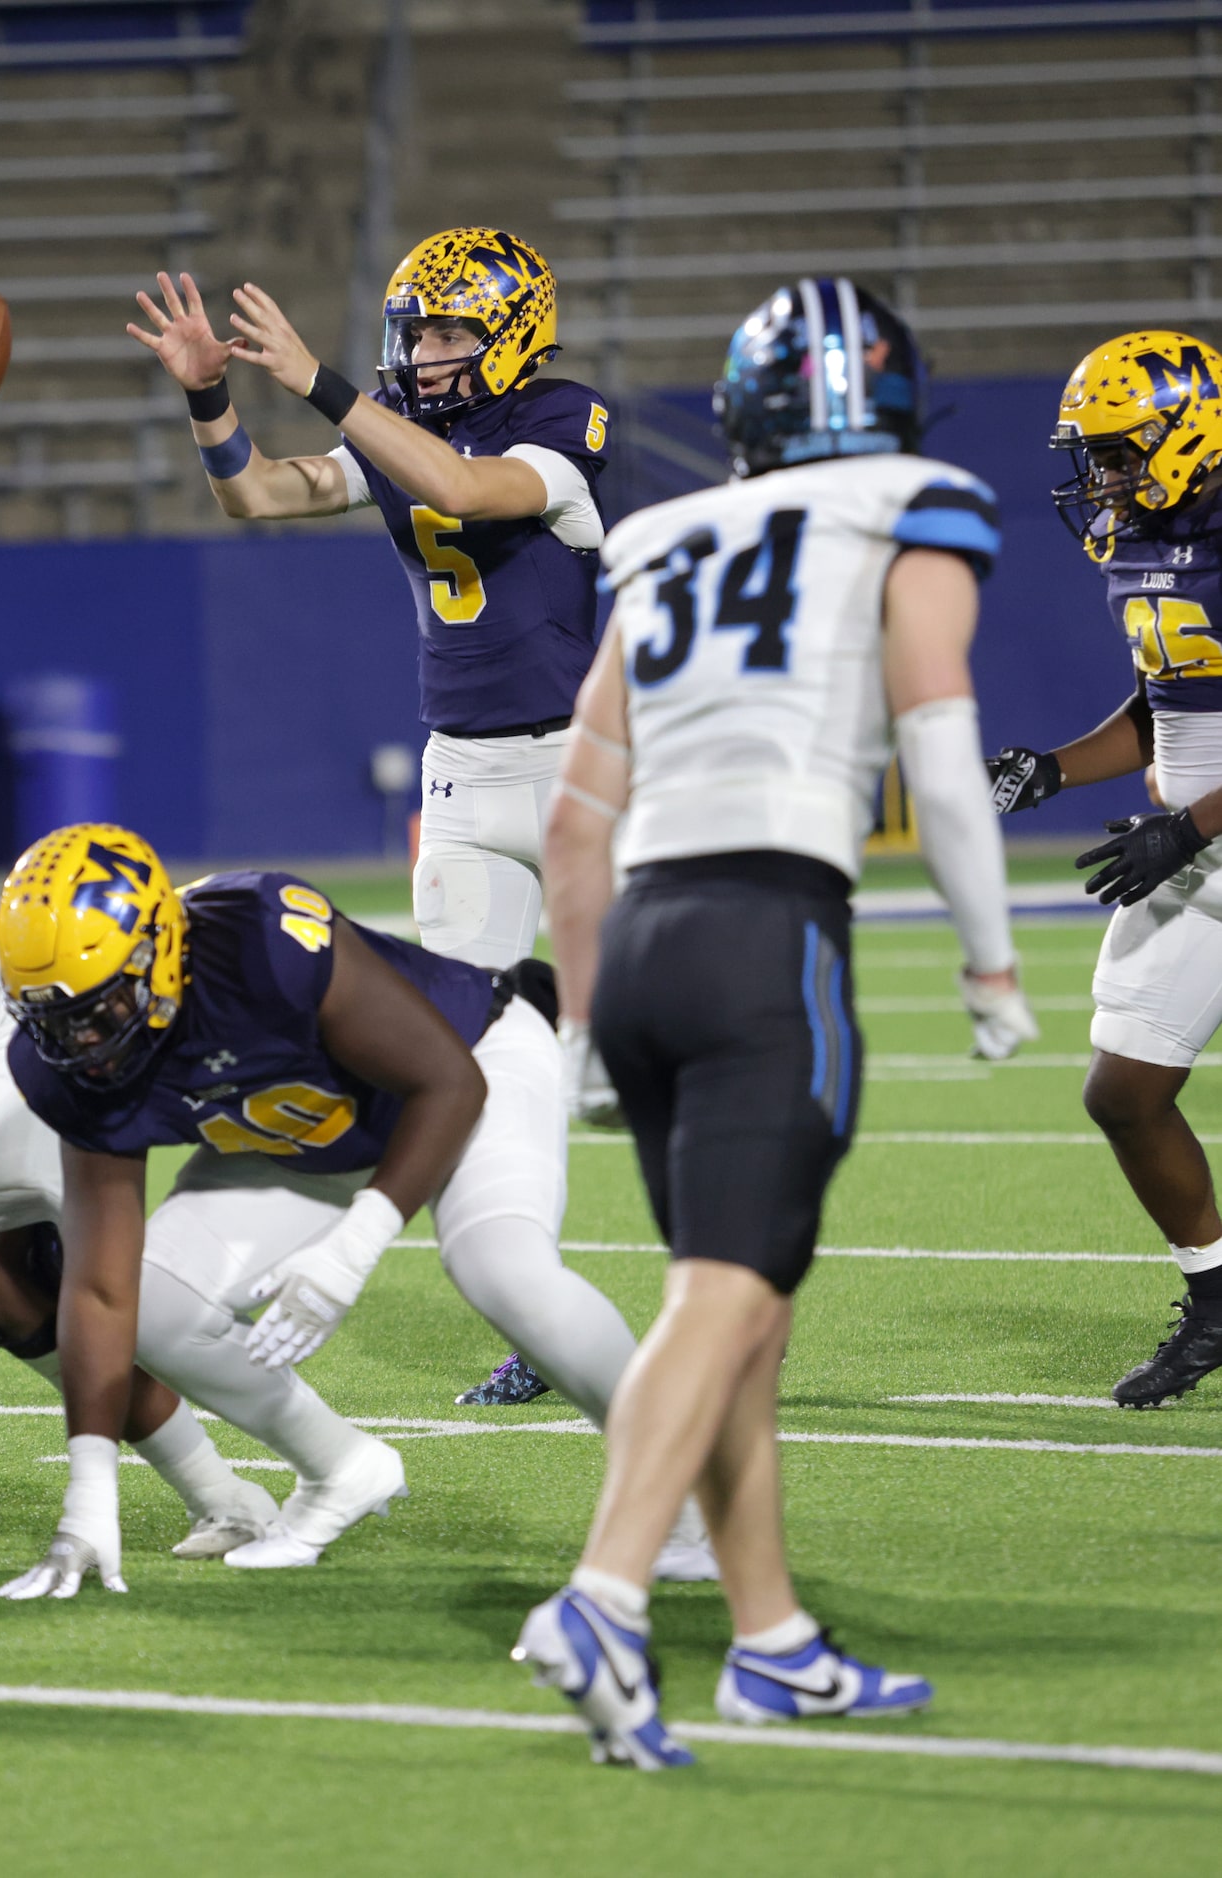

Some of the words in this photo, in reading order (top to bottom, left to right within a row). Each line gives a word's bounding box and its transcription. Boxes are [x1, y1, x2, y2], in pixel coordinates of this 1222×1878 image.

[465, 232, 544, 299] M
[1134, 346, 1220, 410] M
[585, 402, 609, 453] 5
[410, 504, 487, 625] 5
[1141, 572, 1176, 590] LIONS
[627, 508, 808, 692] 34
[278, 884, 332, 953] 40
